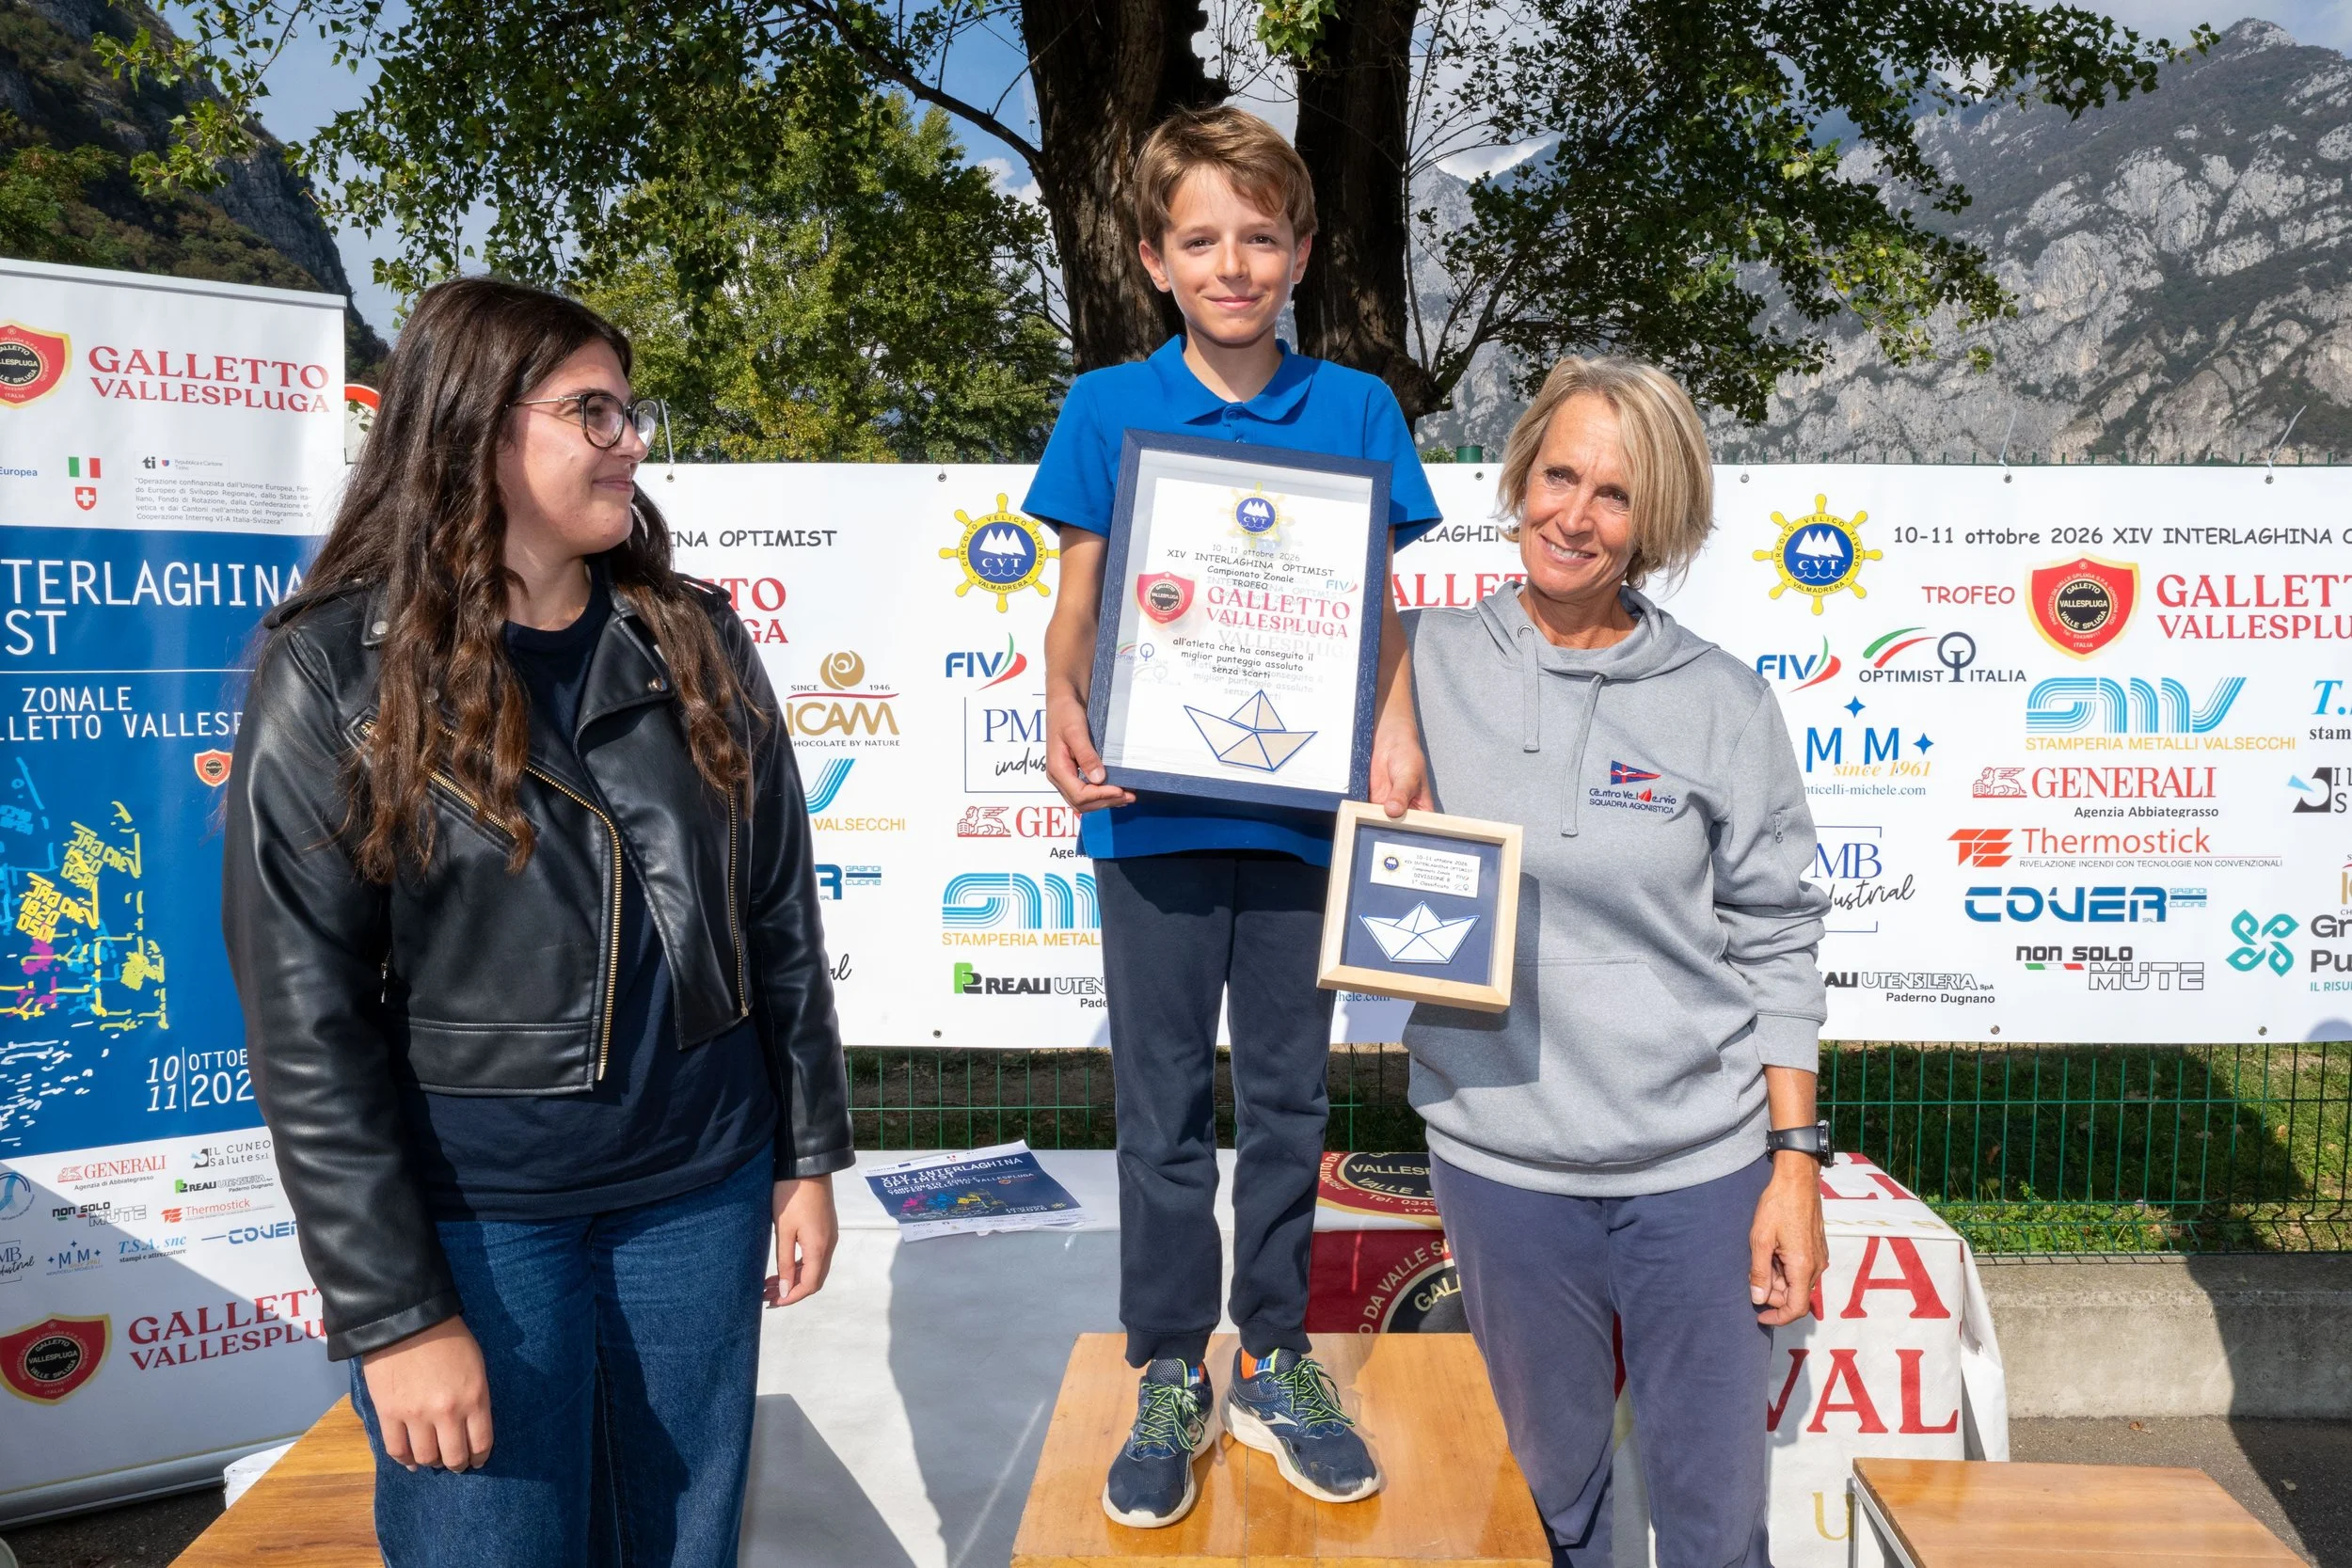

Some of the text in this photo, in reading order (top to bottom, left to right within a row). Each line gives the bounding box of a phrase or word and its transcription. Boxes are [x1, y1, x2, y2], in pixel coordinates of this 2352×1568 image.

[88, 345, 329, 390] GALLETTO
[90, 375, 330, 414] VALLESPLUGA
[986, 515, 1027, 527] VELICO
[1803, 515, 1845, 528] VELICO
[719, 530, 838, 547] OPTIMIST
[960, 523, 977, 567] CIRCOLO
[1893, 526, 1954, 546] 10-11
[1965, 526, 2042, 546] ottobre
[2050, 526, 2105, 546] 2026
[2112, 526, 2153, 546] XIV
[2162, 527, 2333, 546] INTERLAGHINA
[1031, 530, 1043, 566] TIVANO
[1212, 544, 1300, 562] 10 ottobre 2026
[1775, 526, 1795, 569] CIRCOLO
[1849, 531, 1861, 567] TIVANO
[1167, 548, 1336, 578] XIV INTERLAGHINA OPTIMIST
[1207, 565, 1295, 584] Campionato Zonale
[977, 578, 1029, 592] VALMADRERA
[1232, 579, 1268, 591] TROFEO
[1326, 579, 1350, 592] FIV
[1792, 581, 1845, 594] VALMADRERA
[2066, 582, 2101, 594] GALLETTO
[1207, 586, 1351, 621] GALLETTO
[1921, 585, 2016, 606] TROFEO
[2059, 599, 2108, 608] VALLESPLUGA
[1205, 607, 1349, 639] VALLESPLUGA
[2060, 610, 2107, 630] VALLE SPLUGA
[6, 609, 67, 656] ST
[1172, 637, 1314, 662] all'atleta che ha conseguito il
[945, 651, 1003, 679] FIV
[1181, 650, 1213, 663] miglior
[1216, 656, 1262, 669] punteggio
[1264, 661, 1304, 673] assoluto
[1756, 654, 1820, 681] FIV
[1212, 665, 1271, 680] senza scarti
[1858, 669, 2027, 684] OPTIMIST ITALIA
[790, 684, 892, 692] SINCE 1946
[23, 687, 133, 714] ZONALE
[787, 701, 900, 736] ICAM
[850, 739, 901, 748] BY NATURE
[1806, 727, 1900, 773] M M
[2026, 737, 2296, 752] STAMPERIA METALLI VALSECCHI
[1832, 760, 1931, 778] since 1961
[2031, 767, 2217, 799] GENERALI
[1589, 787, 1622, 799] Centro
[1589, 798, 1675, 815] SQUADRA AGONISTICA
[2074, 806, 2219, 819] Agenzia Abbiategrasso
[814, 817, 906, 832] VALSECCHI
[2022, 828, 2211, 855] Thermostick
[2019, 859, 2283, 869] RIVELAZIONE INCENDI CON TECNOLOGIE NON CONVENZIONALI
[942, 932, 1039, 947] STAMPERIA
[2073, 945, 2134, 961] SOLO
[1861, 972, 1994, 991] UTENSILERIA SpA
[2089, 961, 2205, 991] MUTE
[985, 977, 1051, 995] REALI
[2311, 982, 2320, 992] IL
[1885, 992, 1996, 1006] Paderno Dugnano
[146, 1054, 180, 1085] 10
[146, 1085, 178, 1113] 11
[209, 1139, 271, 1157] IL CUNEO
[84, 1154, 167, 1180] GENERALI
[210, 1154, 253, 1167] Salute
[917, 1157, 1024, 1179] INTERLAGHINA
[73, 1175, 154, 1192] Agenzia Abbiategrasso
[189, 1181, 217, 1193] REALI
[250, 1181, 275, 1191] Dugnano
[1358, 1178, 1414, 1196] VALLE
[80, 1201, 111, 1213] SOLO
[185, 1198, 251, 1217] Thermostick
[1369, 1194, 1395, 1204] Tel.
[89, 1204, 147, 1227] MUTE
[164, 1236, 187, 1248] snc
[119, 1248, 187, 1264] stampi attrezzature
[1363, 1294, 1385, 1321] DA
[1377, 1247, 1429, 1292] VALLE
[35, 1338, 71, 1353] GALLETTO
[28, 1350, 78, 1365] VALLESPLUGA
